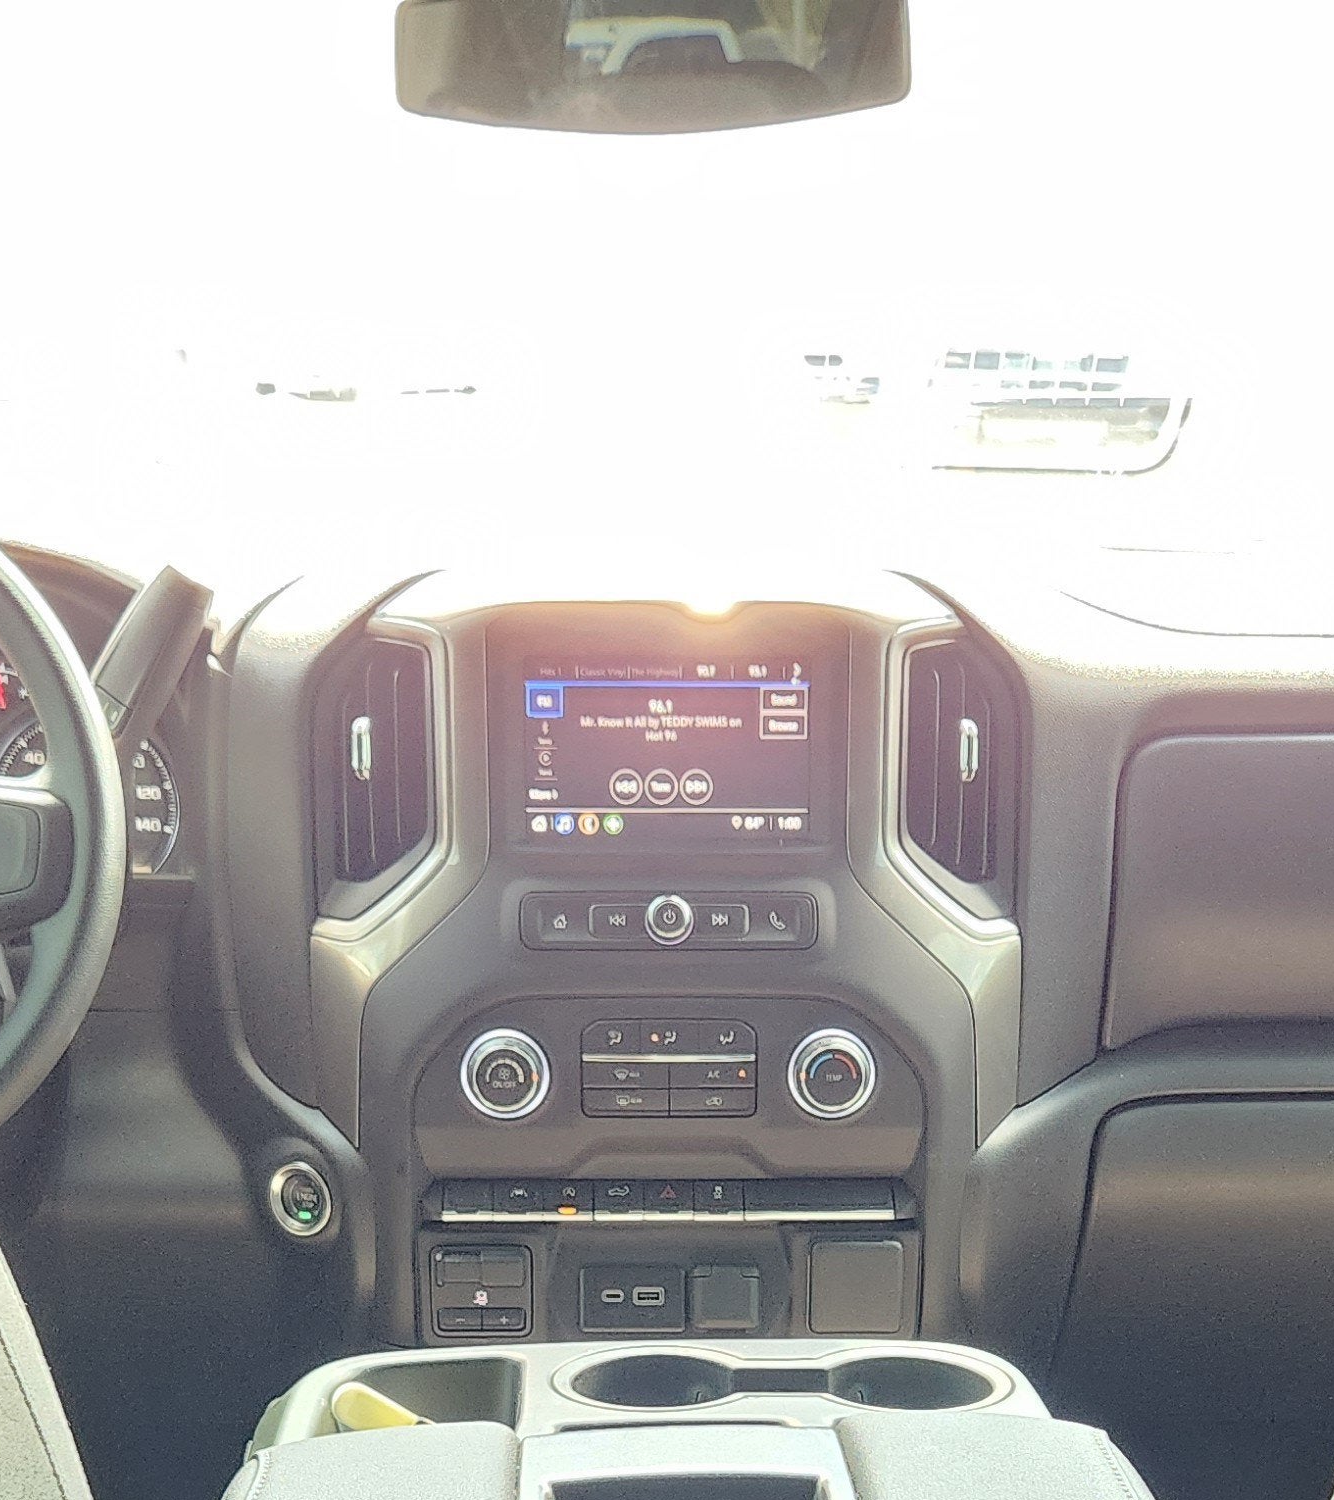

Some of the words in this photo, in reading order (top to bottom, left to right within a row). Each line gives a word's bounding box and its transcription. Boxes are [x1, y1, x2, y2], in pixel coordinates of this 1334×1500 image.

[579, 668, 605, 677] Classic
[648, 698, 673, 714] 96.1
[579, 715, 596, 728] Mr.
[597, 715, 624, 728] Know
[634, 715, 647, 728] All
[648, 715, 660, 730] by
[660, 715, 694, 728] TEDDY
[694, 715, 727, 728] SWIMS
[729, 717, 742, 728] on
[645, 729, 663, 741] Hot
[664, 729, 677, 741] 96
[23, 750, 45, 765] 40
[136, 785, 161, 800] 120
[135, 816, 161, 832] 140
